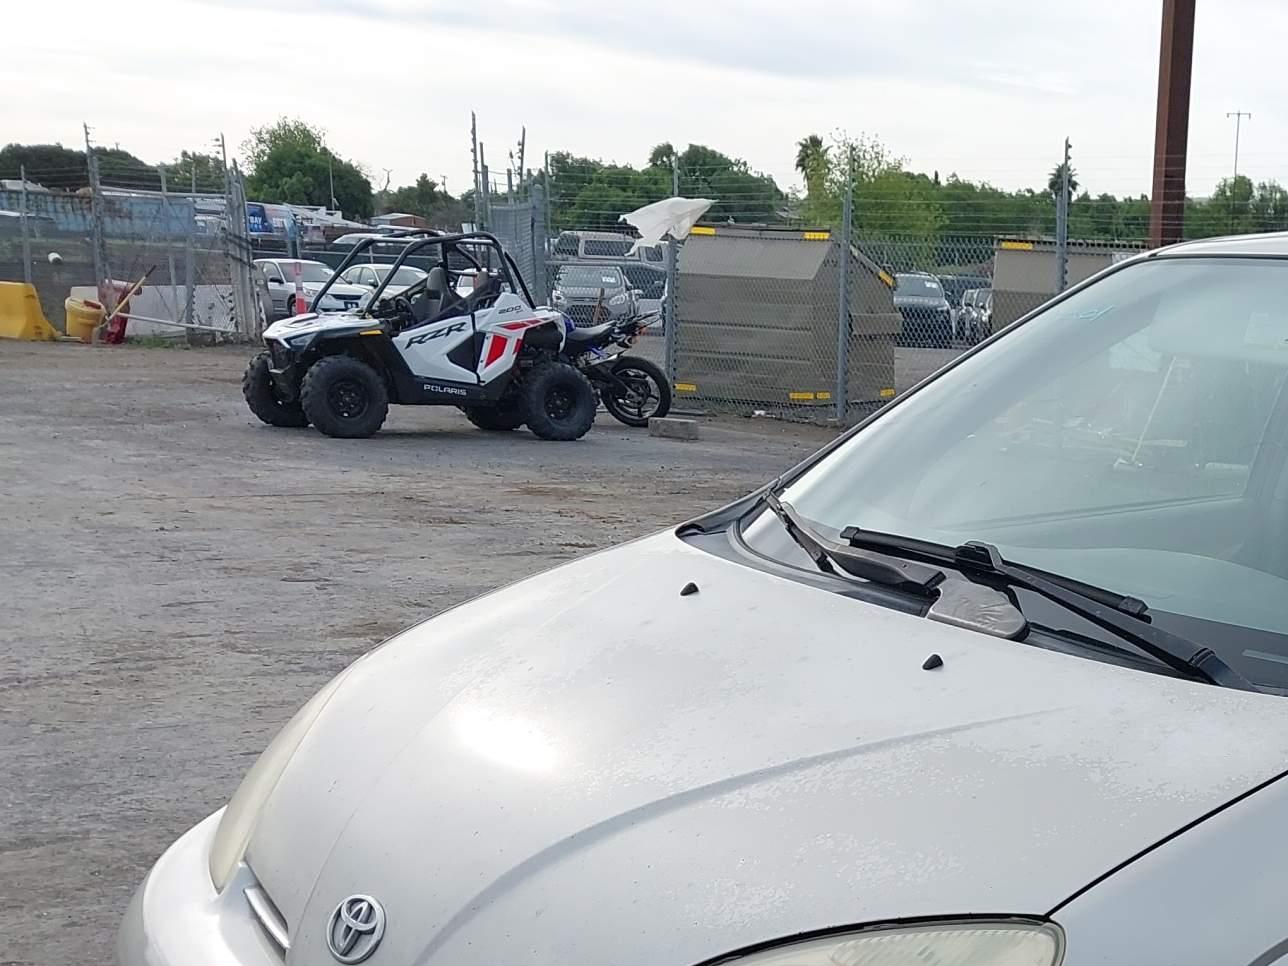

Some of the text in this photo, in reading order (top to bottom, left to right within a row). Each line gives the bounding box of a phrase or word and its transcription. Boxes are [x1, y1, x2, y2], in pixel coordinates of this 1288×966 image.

[498, 305, 521, 315] 200
[405, 322, 467, 349] RZR
[424, 384, 467, 396] POLARIS
